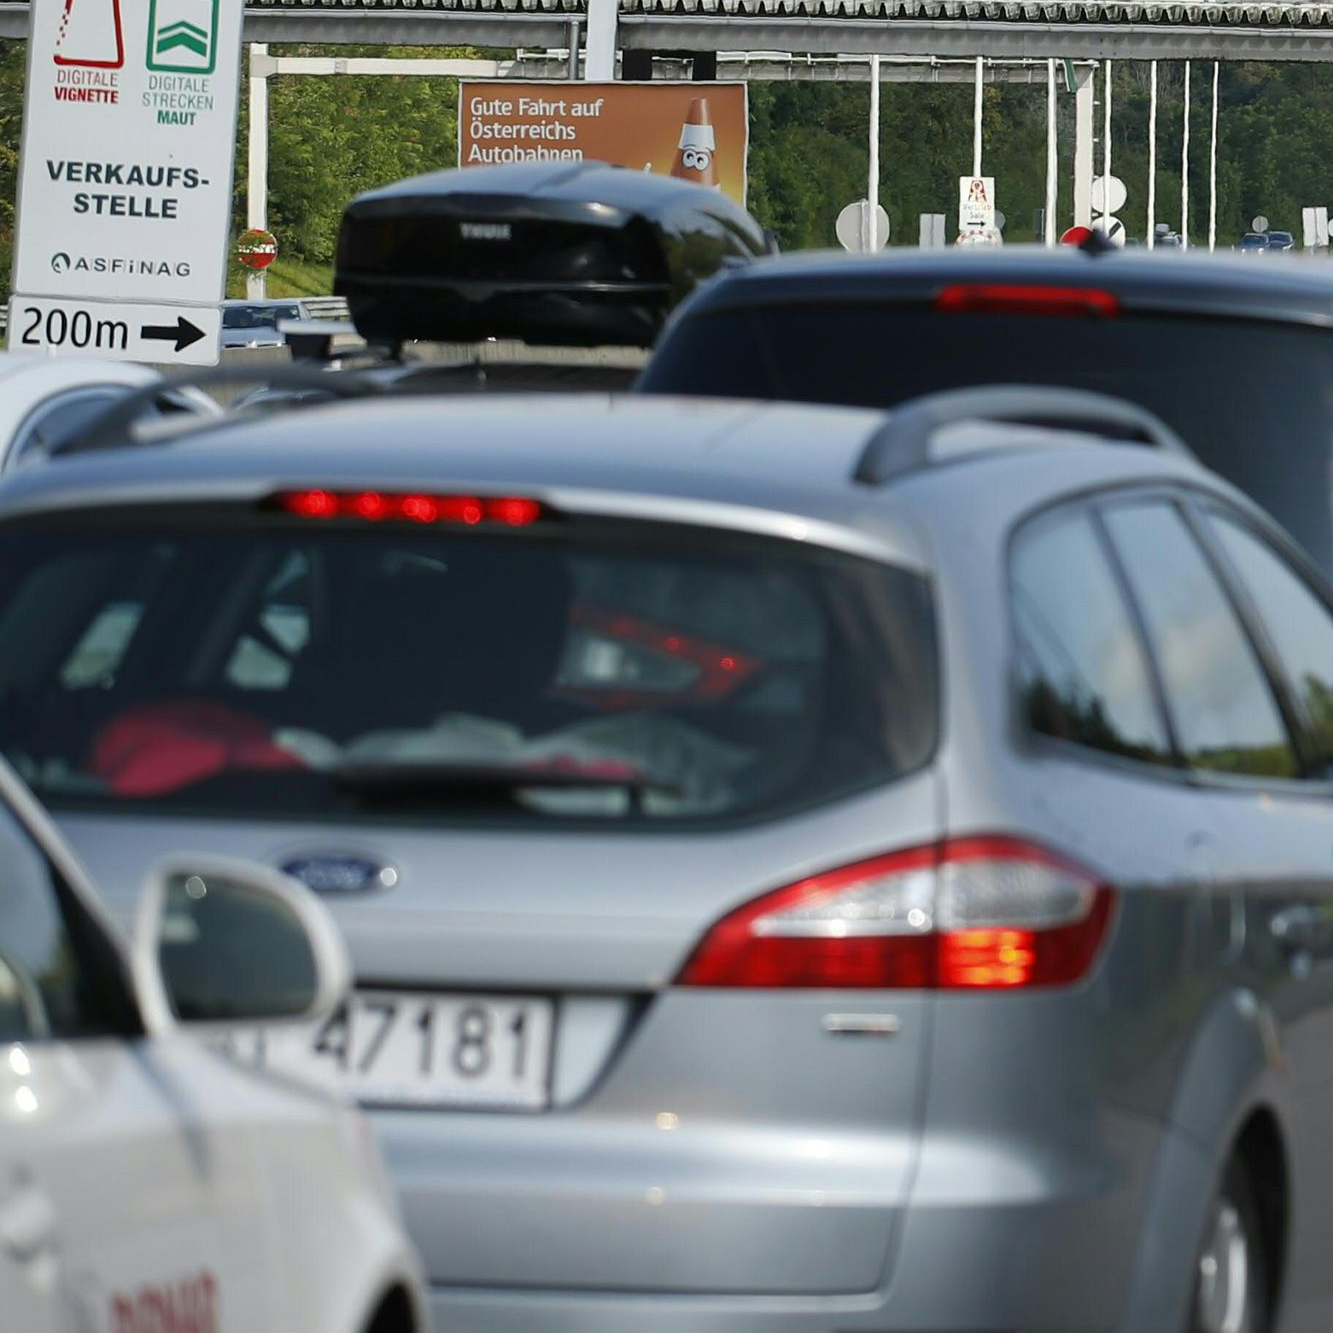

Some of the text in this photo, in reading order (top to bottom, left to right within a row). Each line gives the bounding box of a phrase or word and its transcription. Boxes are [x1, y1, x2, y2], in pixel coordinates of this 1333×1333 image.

[57, 69, 119, 88] DIGITALE
[148, 76, 209, 93] DIGITALE
[54, 86, 119, 104] VIGNETTE
[142, 92, 214, 110] STRECKEN
[471, 97, 605, 117] Gute Fahrt auf
[157, 110, 197, 126] MAUT
[470, 117, 576, 140] Österreichs
[468, 144, 583, 163] Autobahnen
[46, 160, 210, 189] VERKAUFS-
[73, 193, 179, 219] STELLE
[22, 307, 128, 350] 200m
